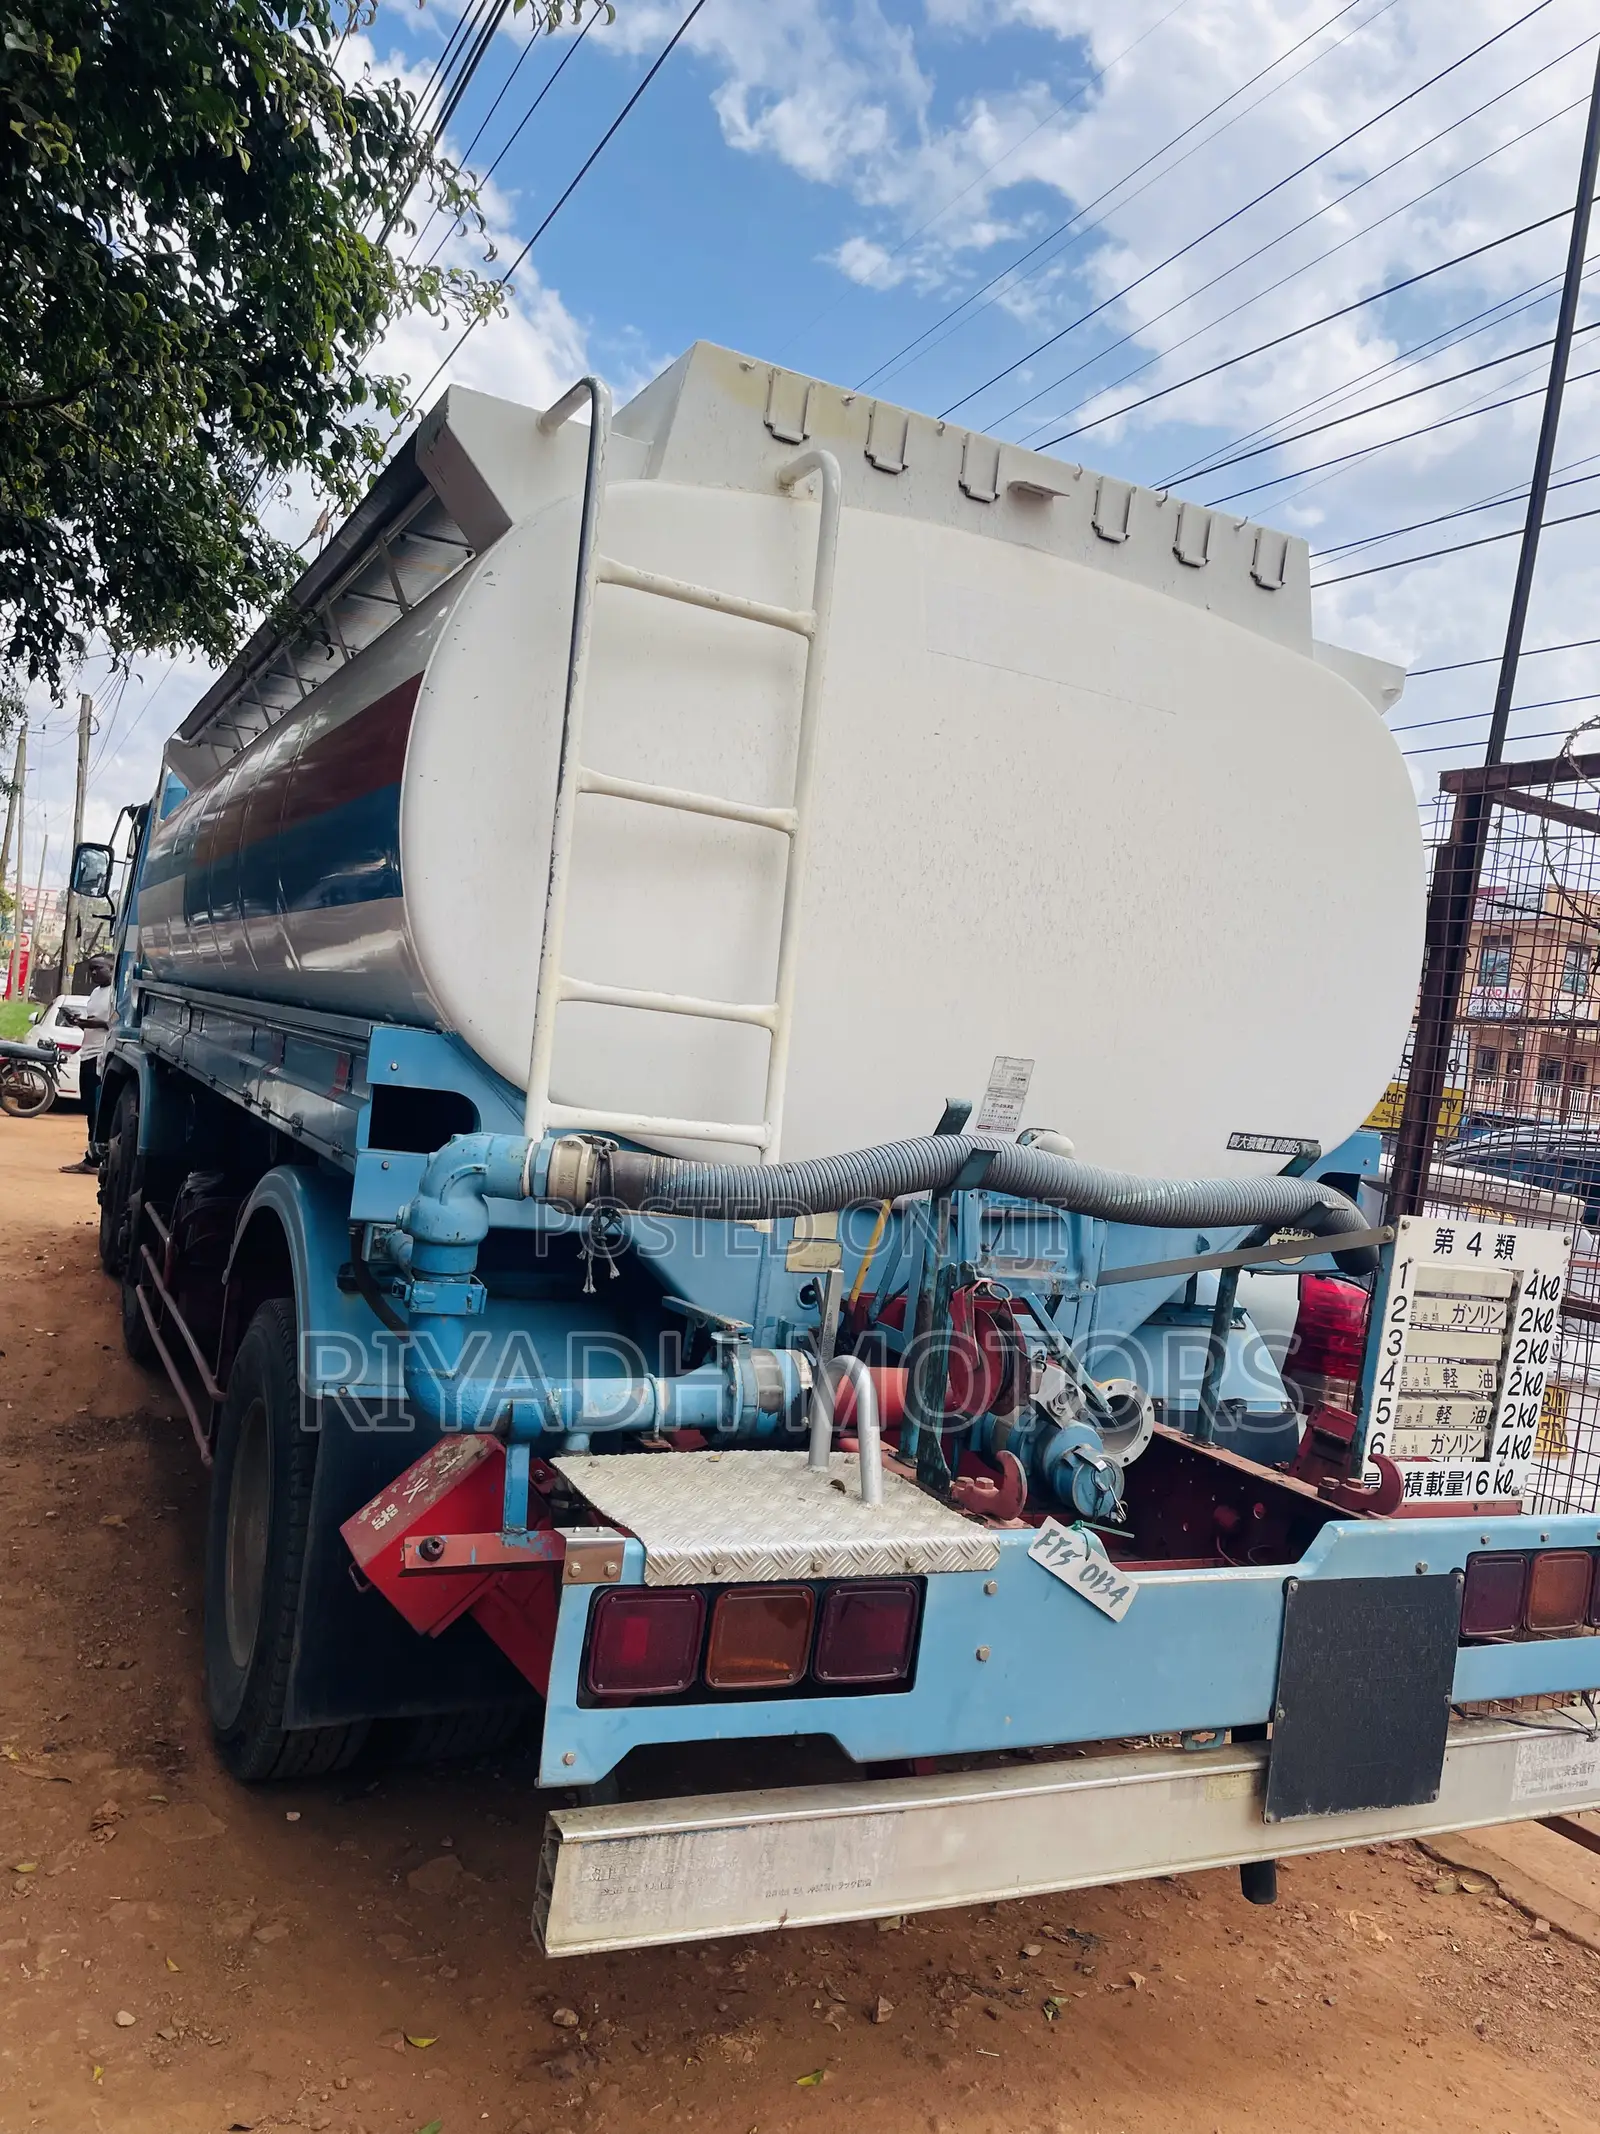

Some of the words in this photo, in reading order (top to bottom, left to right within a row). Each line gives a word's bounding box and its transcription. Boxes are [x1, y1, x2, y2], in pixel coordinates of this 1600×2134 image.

[1399, 1261, 1410, 1289] 1
[1389, 1296, 1408, 1323] 2
[1451, 1302, 1505, 1326] ガソリン
[1386, 1329, 1403, 1357] 3
[1379, 1365, 1396, 1393] 4
[1376, 1398, 1392, 1426] 5
[1370, 1432, 1385, 1457] 6
[1430, 1433, 1483, 1456] ガソリン
